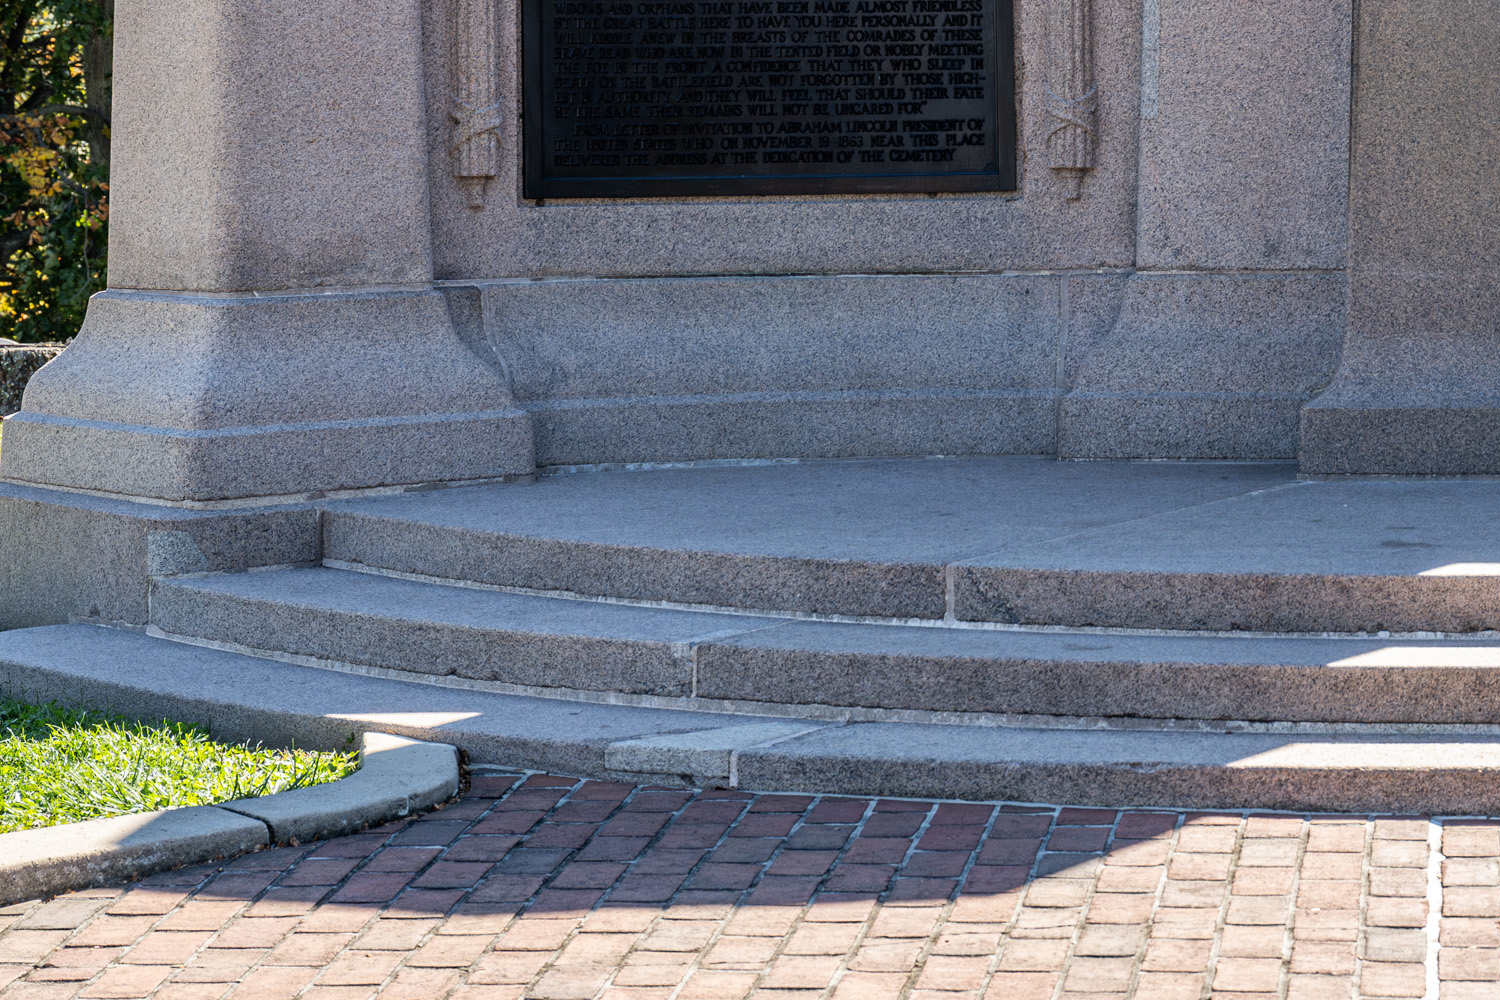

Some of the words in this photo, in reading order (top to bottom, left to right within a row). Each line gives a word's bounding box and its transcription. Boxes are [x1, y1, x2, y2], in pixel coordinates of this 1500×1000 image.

[554, 139, 579, 151] THE
[633, 138, 676, 150] STATES
[682, 137, 714, 149] WHO
[720, 137, 738, 149] ON
[742, 136, 812, 149] NOVEMBER
[838, 135, 864, 147] 1863
[870, 135, 904, 147] NEAR
[910, 134, 939, 147] THIS
[946, 134, 985, 146] PLACE
[624, 153, 650, 165] THE
[656, 152, 707, 165] ADDRESS
[712, 152, 728, 164] AT
[731, 151, 757, 164] THE
[762, 150, 833, 163] DEDICATION
[837, 150, 854, 162] OF
[858, 150, 884, 162] THE
[889, 149, 955, 162] CEMETERY
